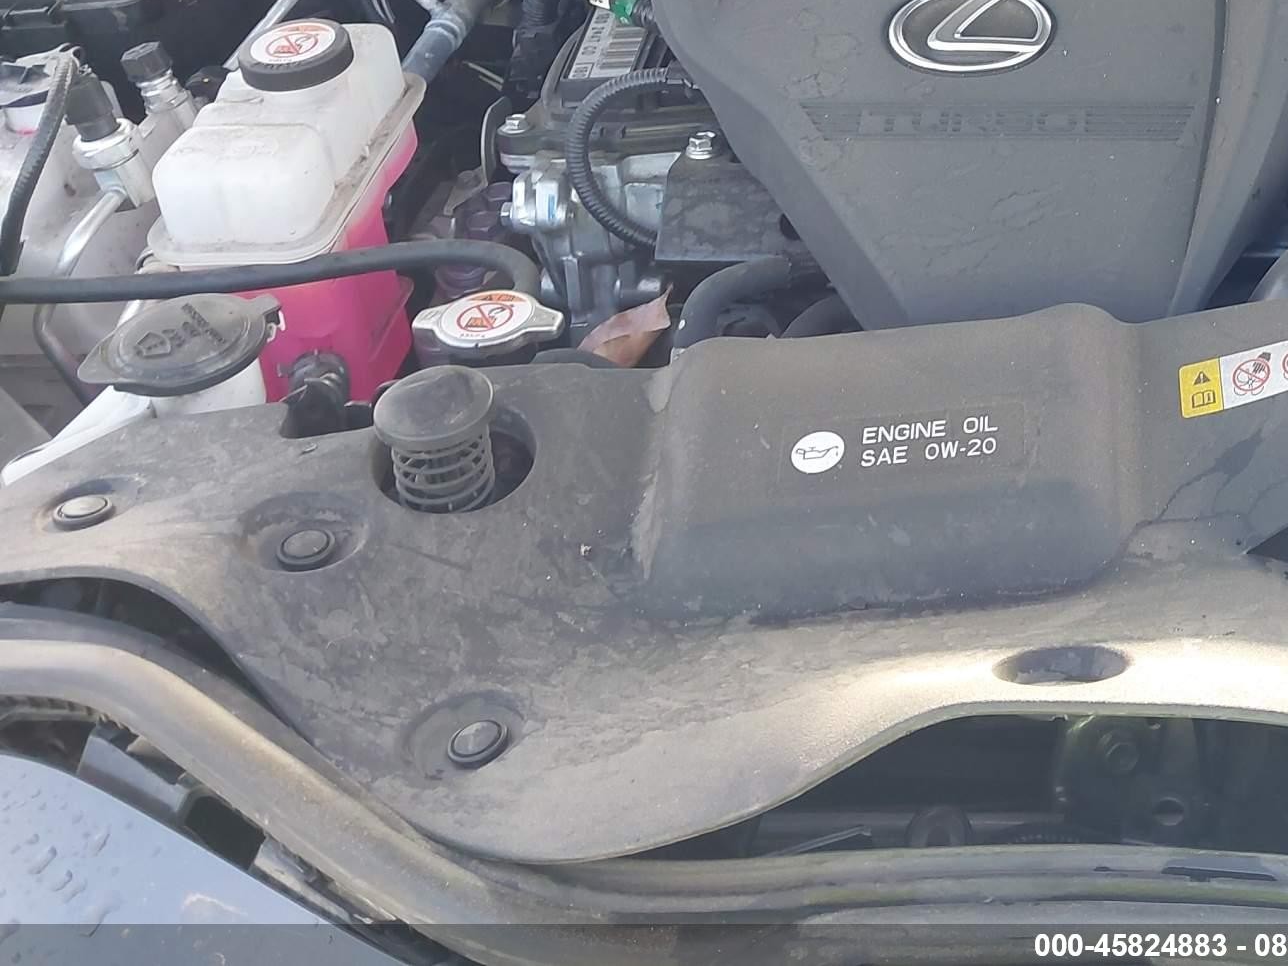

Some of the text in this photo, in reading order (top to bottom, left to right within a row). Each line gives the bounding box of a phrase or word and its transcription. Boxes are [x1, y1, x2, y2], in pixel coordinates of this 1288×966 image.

[862, 415, 998, 445] ENGINE OIL
[860, 437, 997, 467] SAE 0W-20
